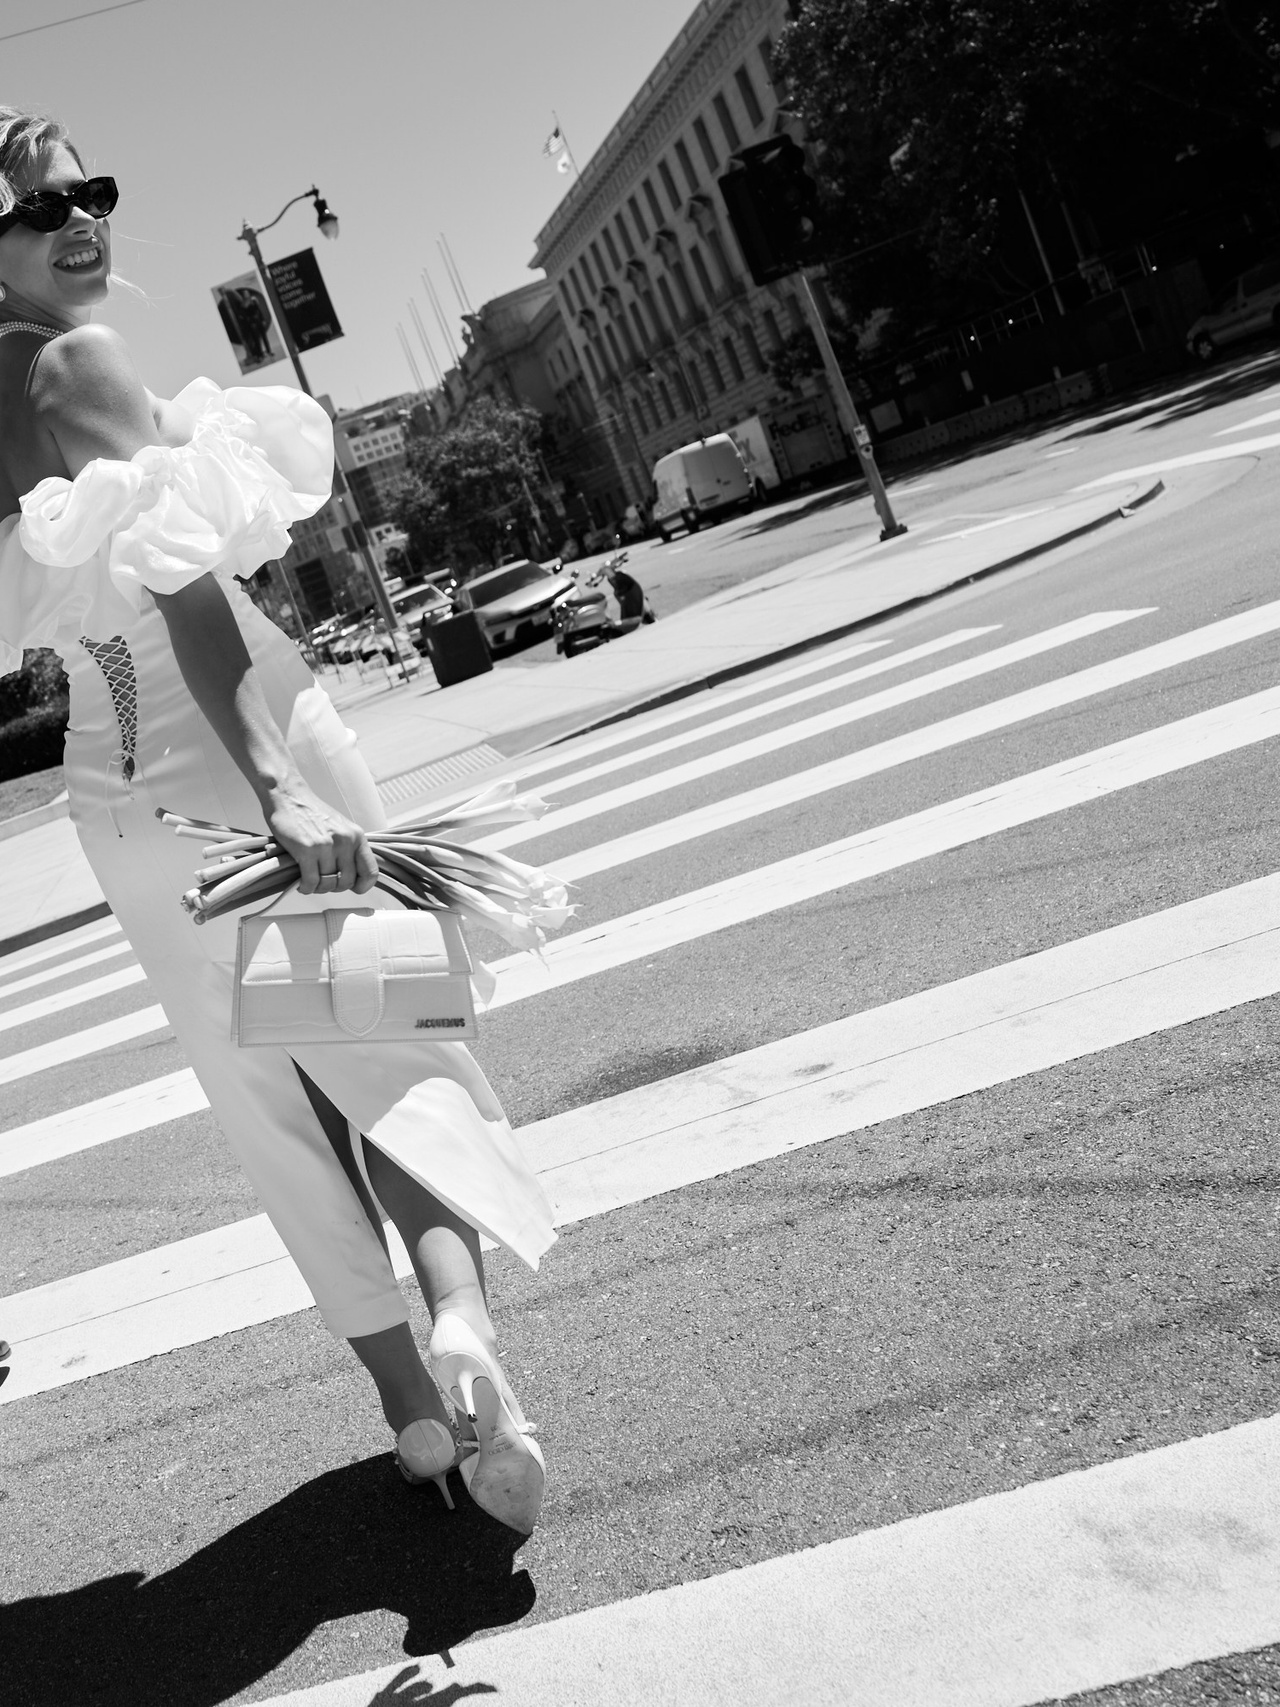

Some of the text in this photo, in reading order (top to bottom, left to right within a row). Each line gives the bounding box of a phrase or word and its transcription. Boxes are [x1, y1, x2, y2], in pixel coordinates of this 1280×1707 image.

[271, 261, 298, 276] Where
[278, 278, 303, 293] voices
[280, 288, 303, 301] come
[283, 291, 316, 310] together
[769, 411, 828, 440] FedEx
